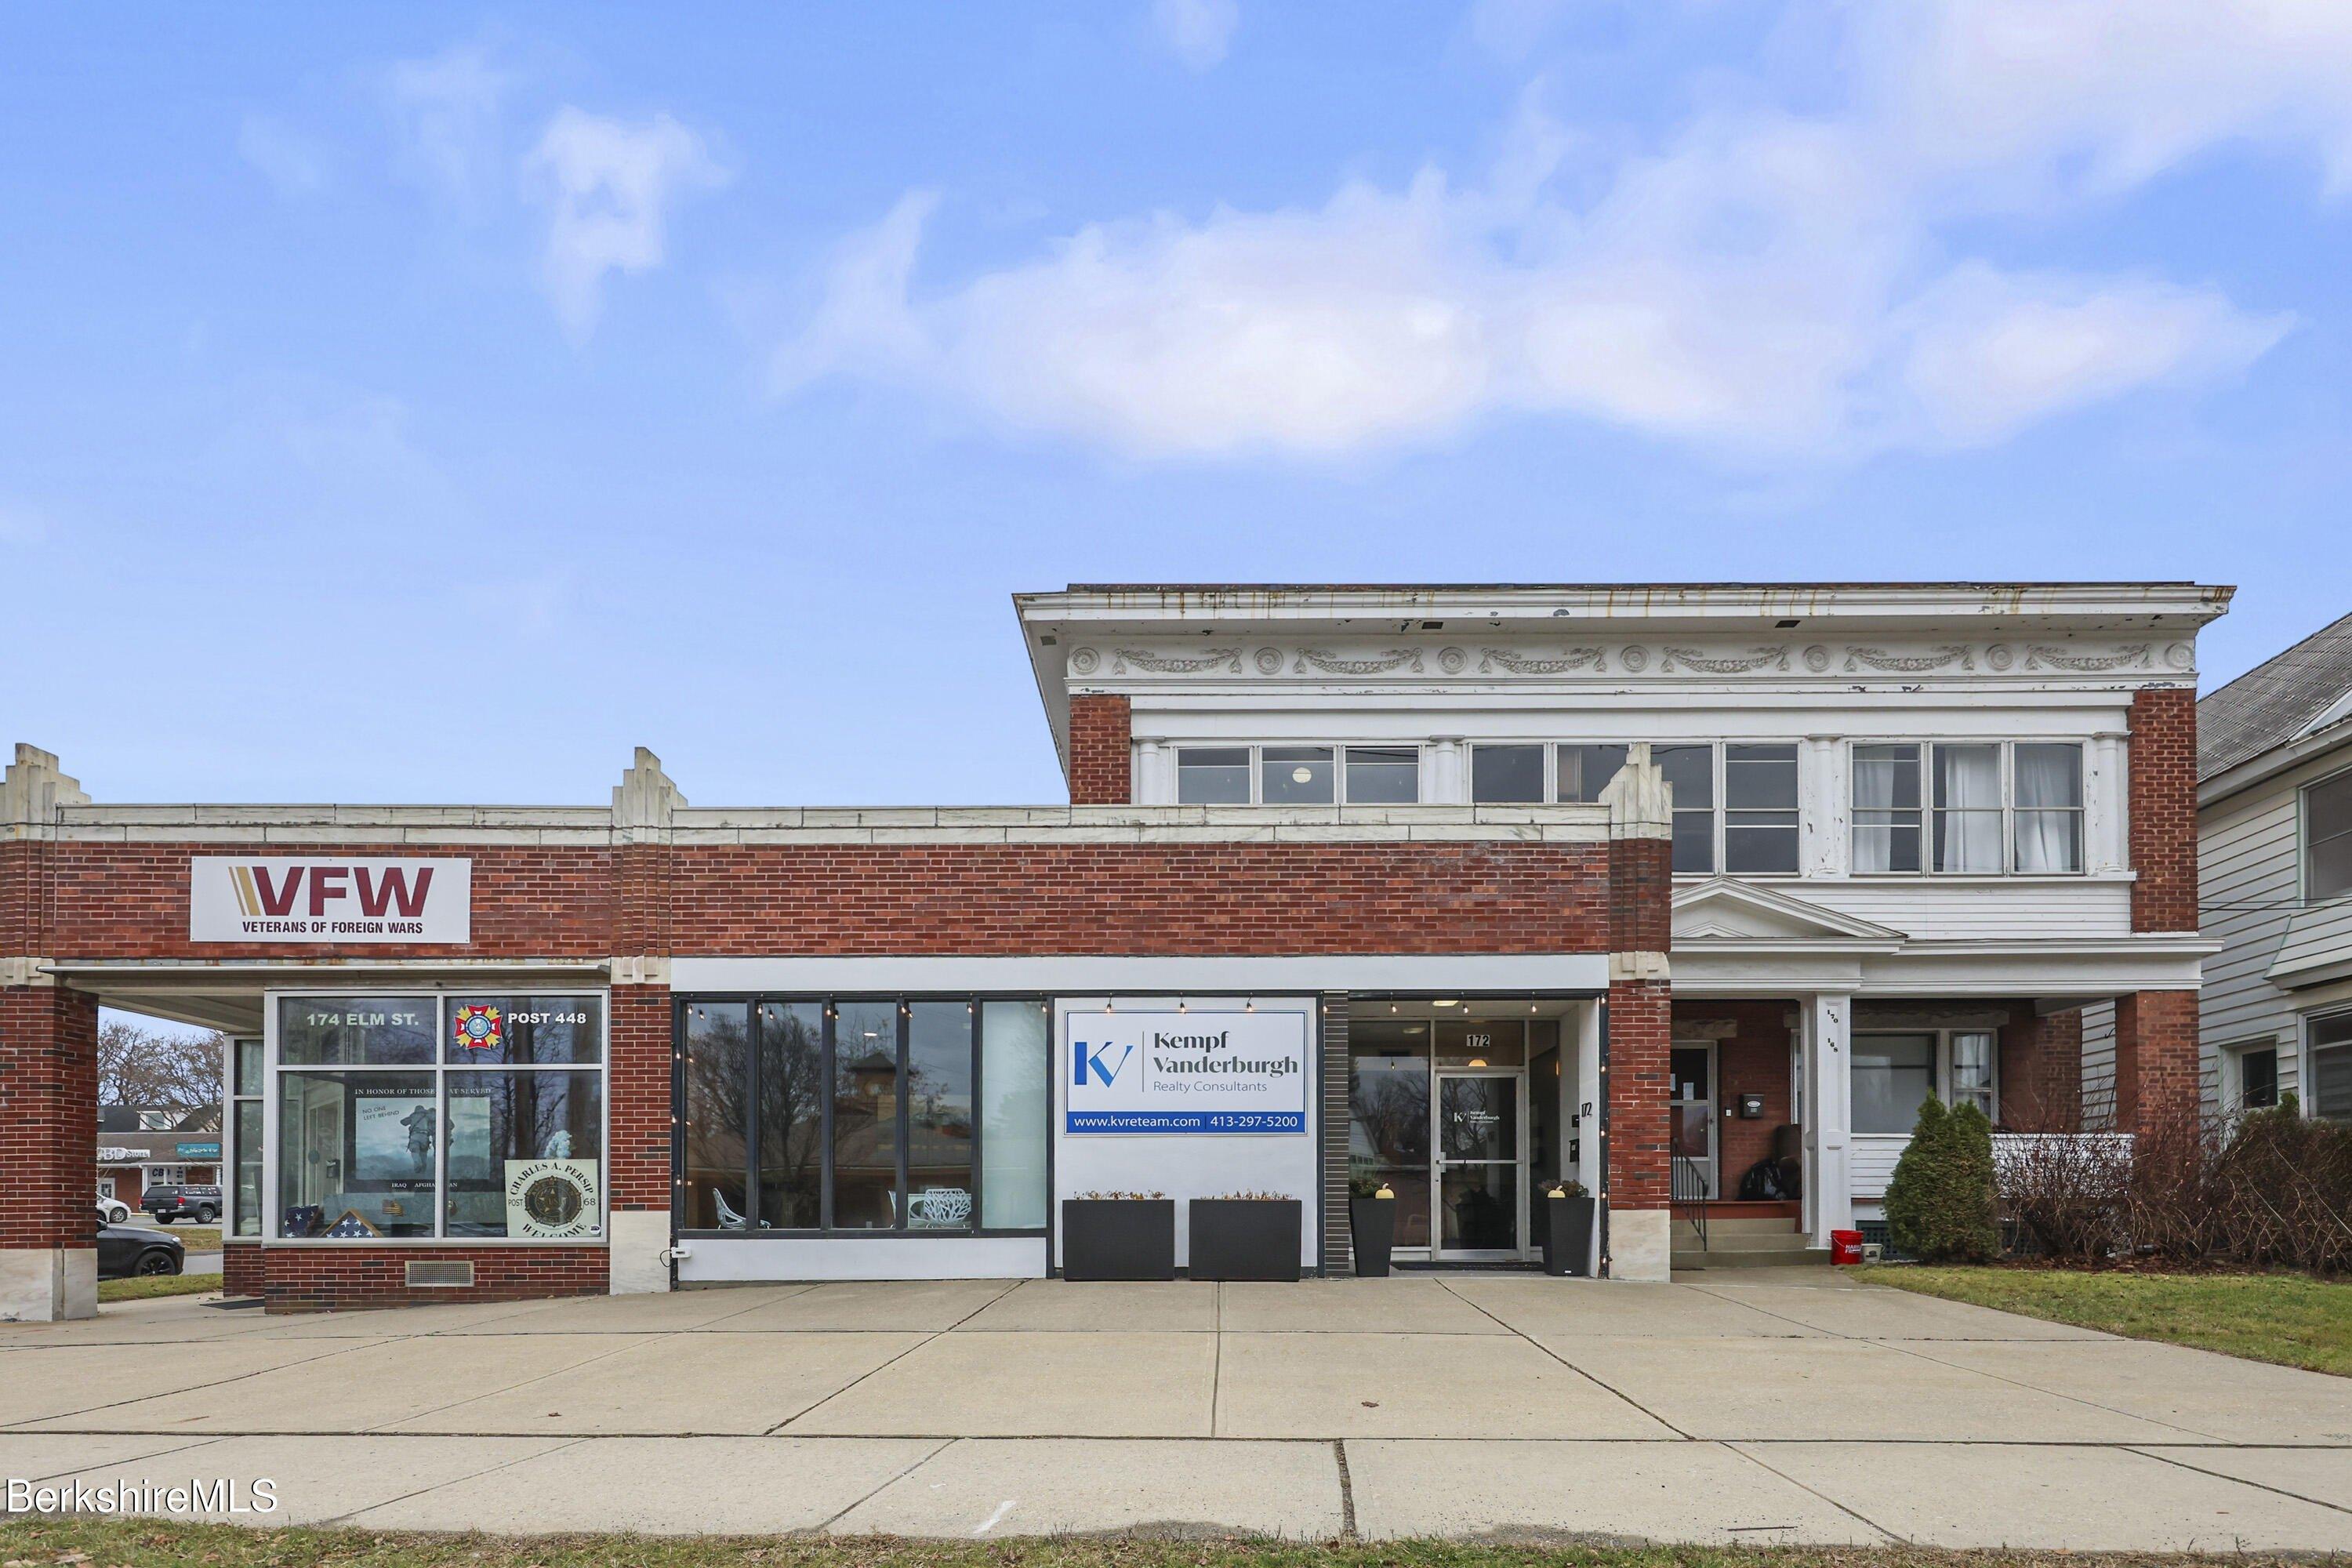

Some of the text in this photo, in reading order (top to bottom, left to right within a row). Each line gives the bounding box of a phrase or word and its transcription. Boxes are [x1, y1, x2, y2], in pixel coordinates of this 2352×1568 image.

[252, 866, 434, 917] VFW
[242, 921, 423, 935] VETERANS OF FOREIGN WARS
[307, 1013, 419, 1025] 174 ELM ST.
[507, 1012, 586, 1024] POST 448
[1154, 1031, 1230, 1053] Kempf
[1468, 1035, 1490, 1047] 172
[1074, 1041, 1134, 1088] KV
[1153, 1056, 1298, 1078] Vanderburgh
[1153, 1080, 1268, 1094] Realty Consultants
[378, 1110, 400, 1119] BEHIND
[1074, 1116, 1298, 1127] www.kvreteam.com 413-297-5200
[510, 1162, 594, 1196] CHARLES A. PERSIP
